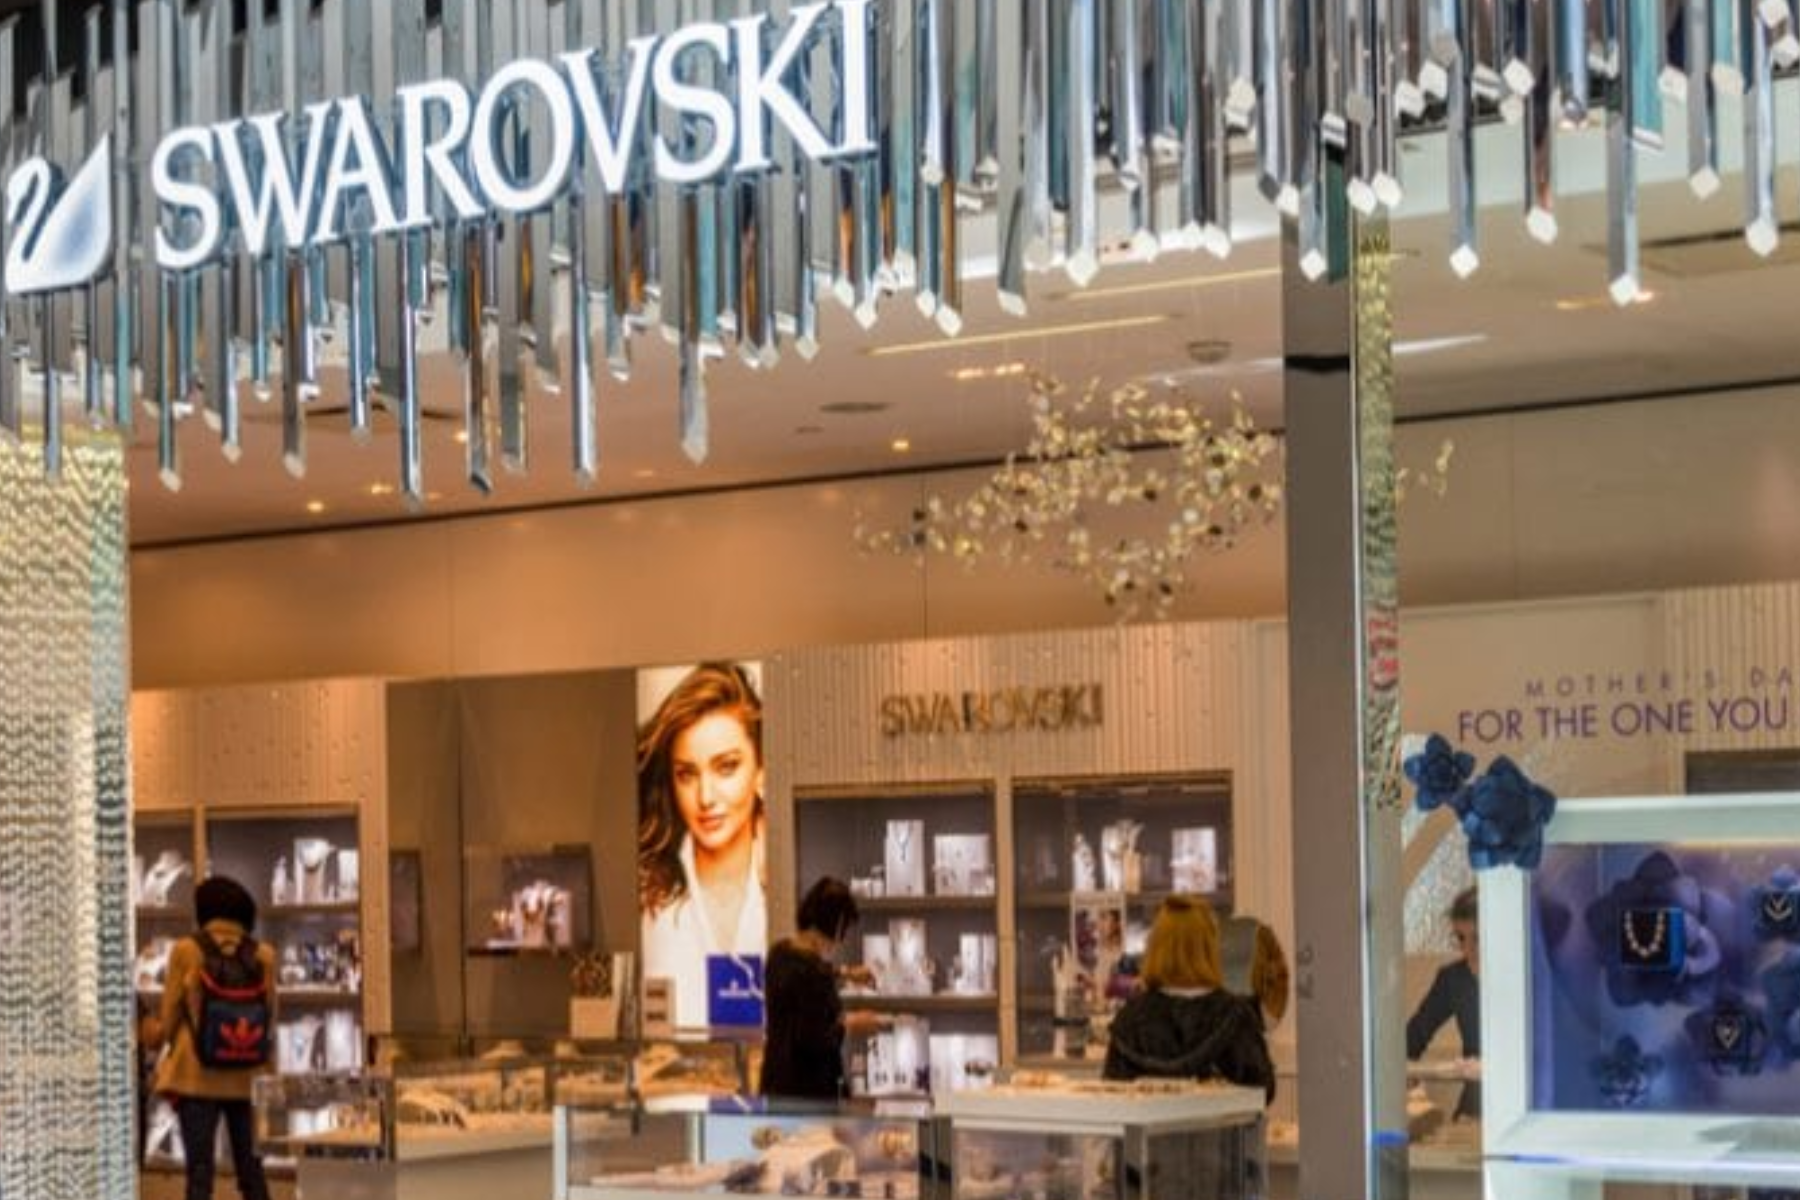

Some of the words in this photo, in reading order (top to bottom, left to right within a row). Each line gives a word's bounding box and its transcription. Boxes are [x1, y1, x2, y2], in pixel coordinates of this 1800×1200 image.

[150, 0, 878, 270] SWAROVSKI
[1459, 709, 1524, 742] FOR
[1535, 704, 1600, 739] THE
[1610, 700, 1693, 736] ONE
[1707, 697, 1788, 732] YOU
